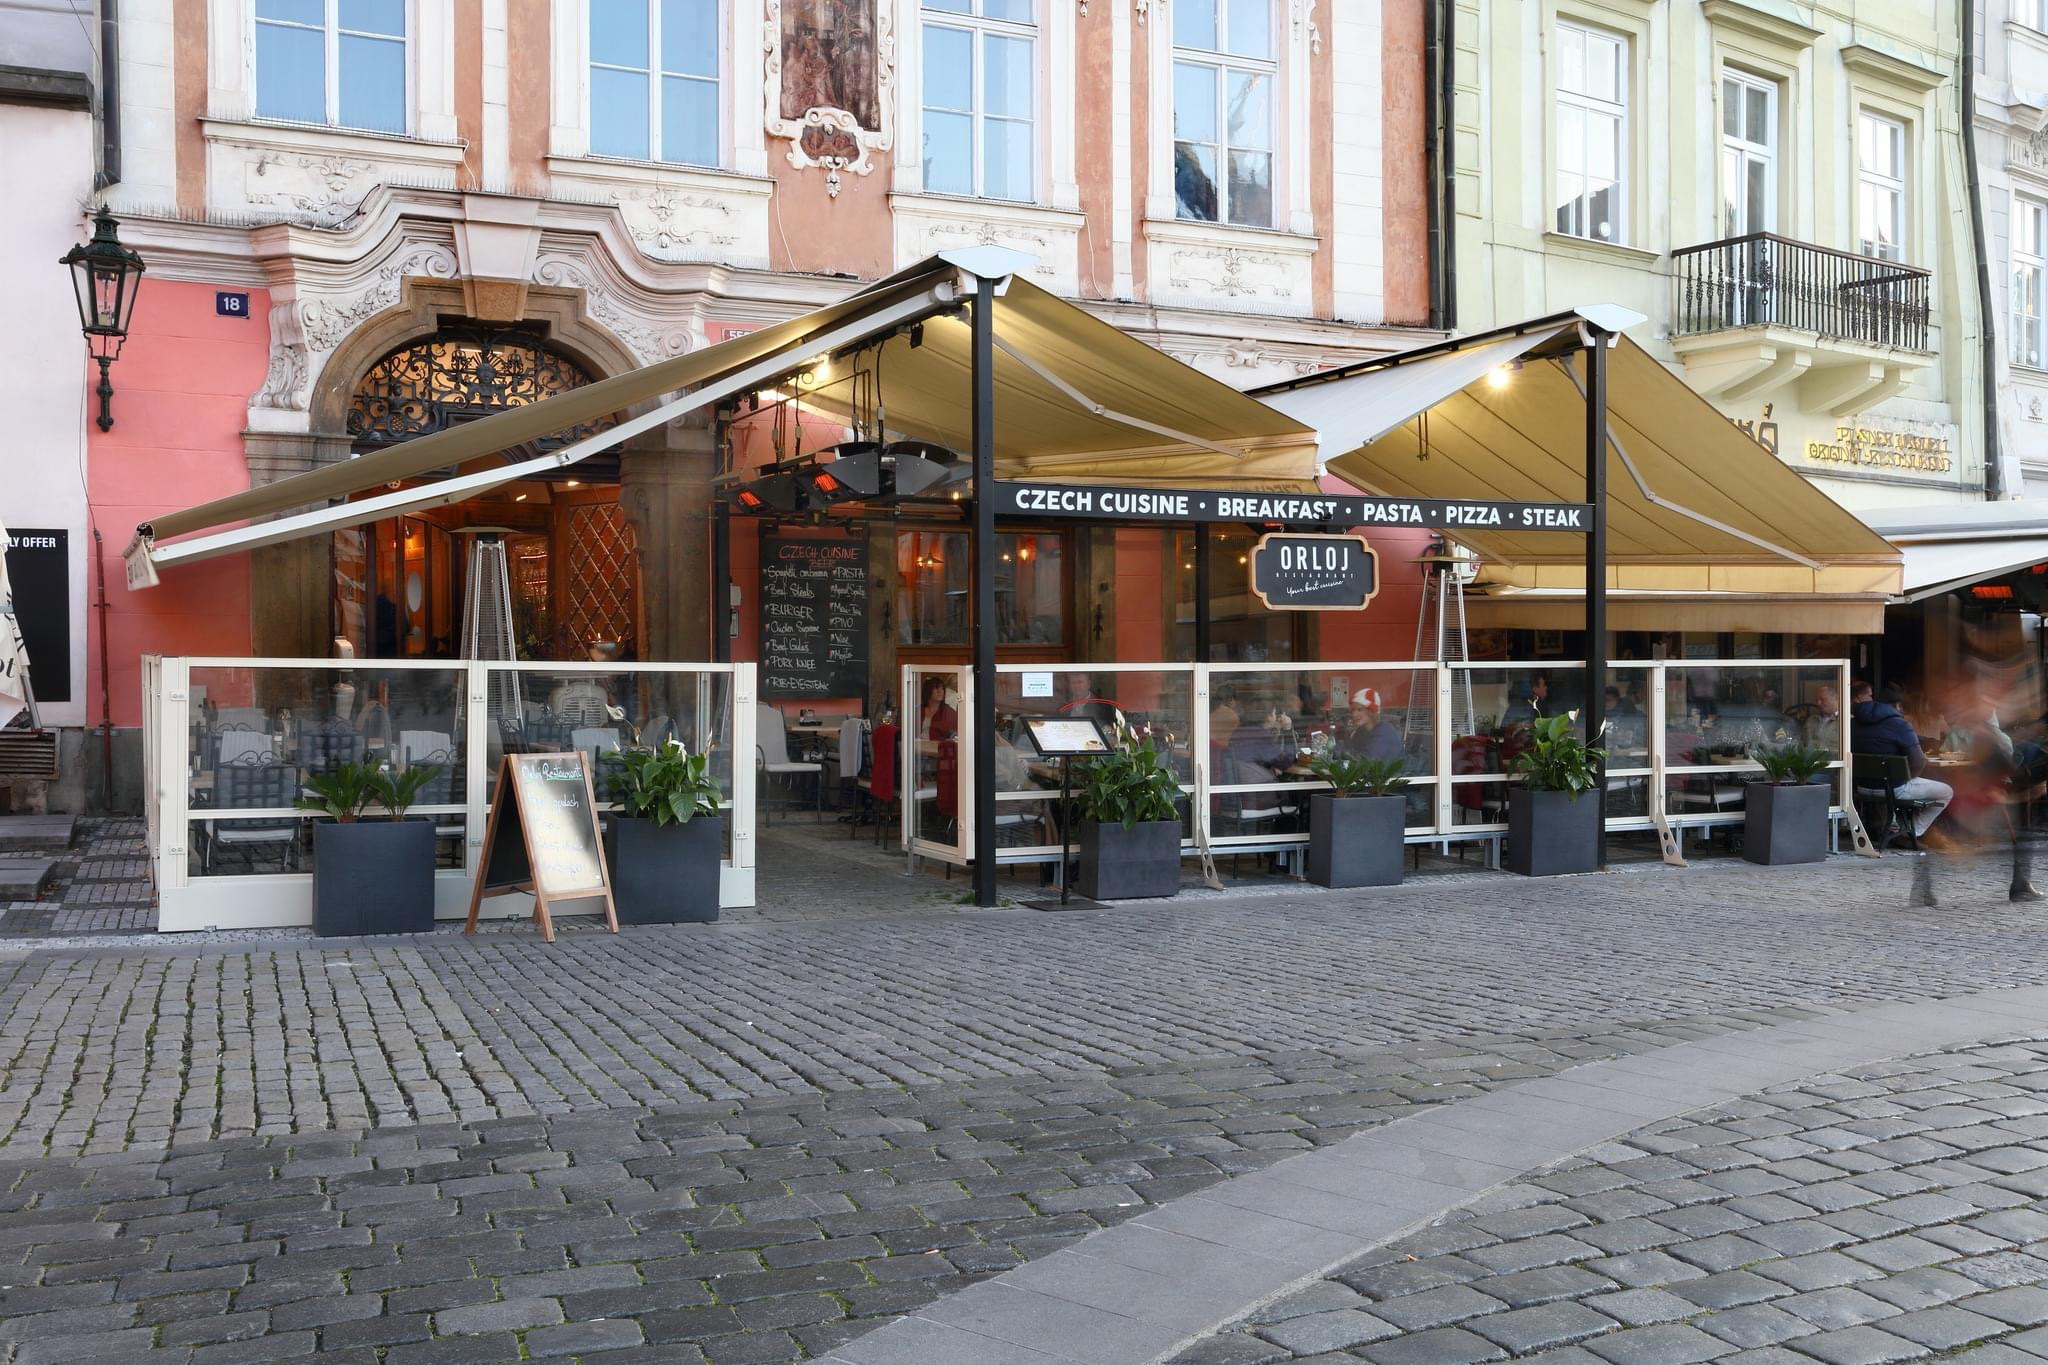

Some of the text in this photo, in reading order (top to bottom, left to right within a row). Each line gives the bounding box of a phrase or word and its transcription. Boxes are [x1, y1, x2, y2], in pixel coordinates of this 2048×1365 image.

[223, 296, 241, 311] 18
[1015, 489, 1581, 527] CZECH CUISINE BREAKFAST PASTA PIZZA STEAK
[22, 536, 56, 548] OFFER
[779, 544, 861, 560] CZECH CUISINE
[1280, 545, 1348, 571] ORLOJ
[836, 566, 865, 579] PASTA
[770, 603, 815, 621] BURGER
[770, 656, 794, 669] PORK
